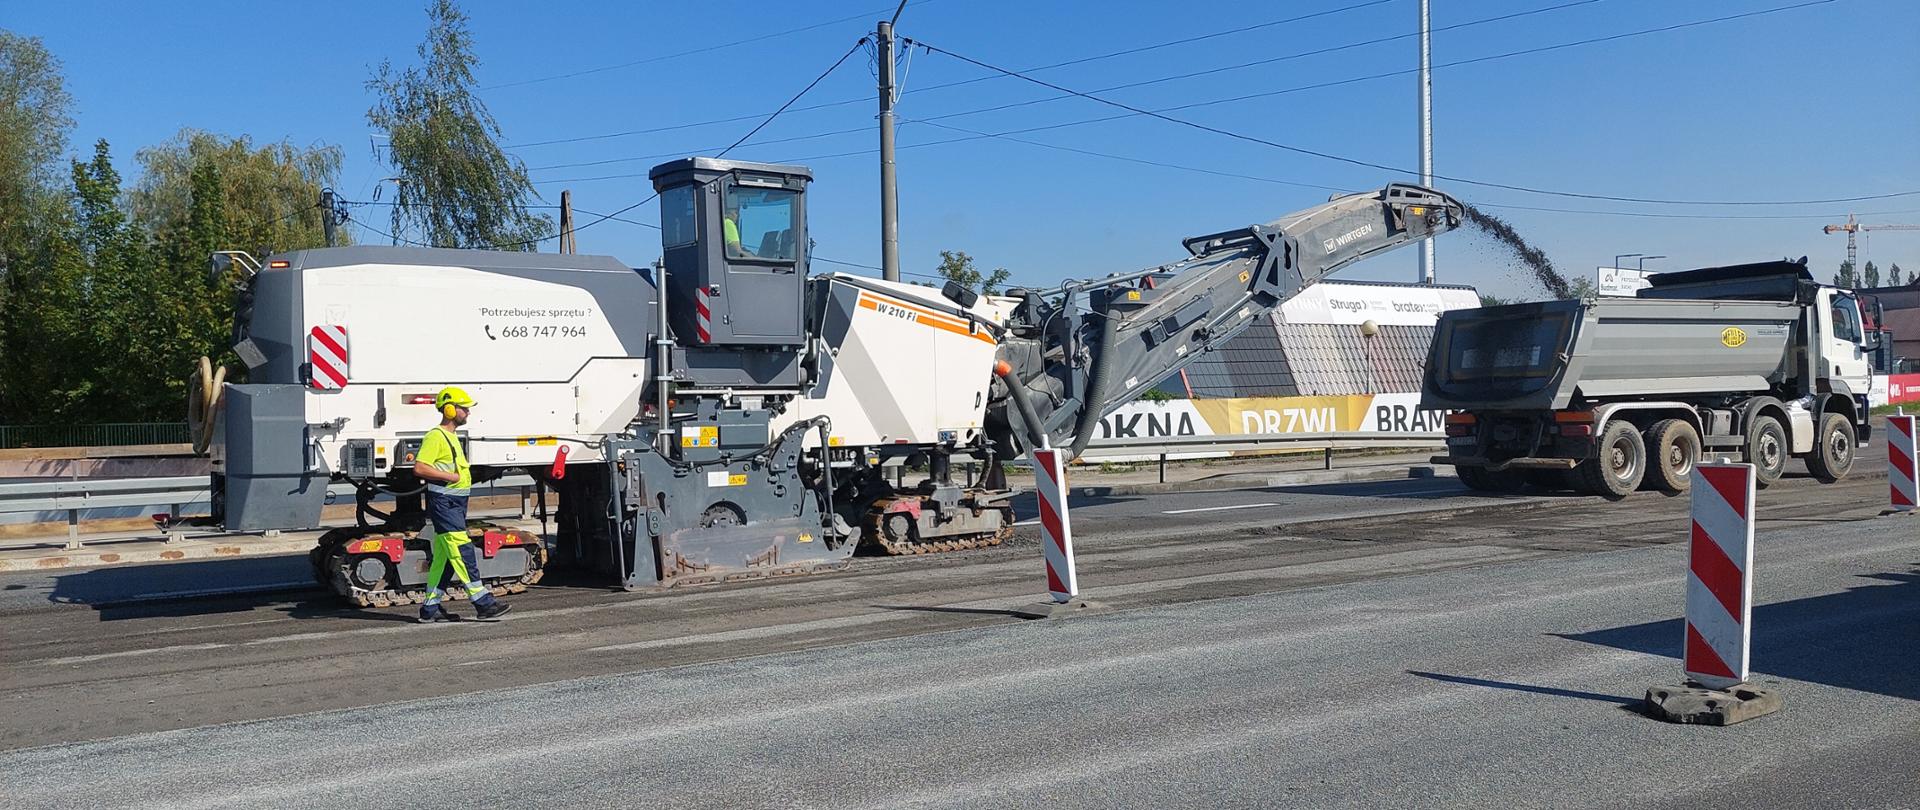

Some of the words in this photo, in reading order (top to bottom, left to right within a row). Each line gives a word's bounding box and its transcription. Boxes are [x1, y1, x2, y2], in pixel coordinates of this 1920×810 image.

[1335, 223, 1373, 246] WIRTGEN
[548, 308, 585, 318] sprzętu
[587, 308, 592, 317] ?
[878, 303, 888, 313] W
[888, 307, 905, 318] 210
[907, 312, 916, 321] Fi
[1329, 299, 1362, 313] Struga
[502, 326, 529, 338] 668
[532, 326, 558, 338] 747
[561, 326, 586, 338] 964
[1241, 407, 1337, 435] DRZWI
